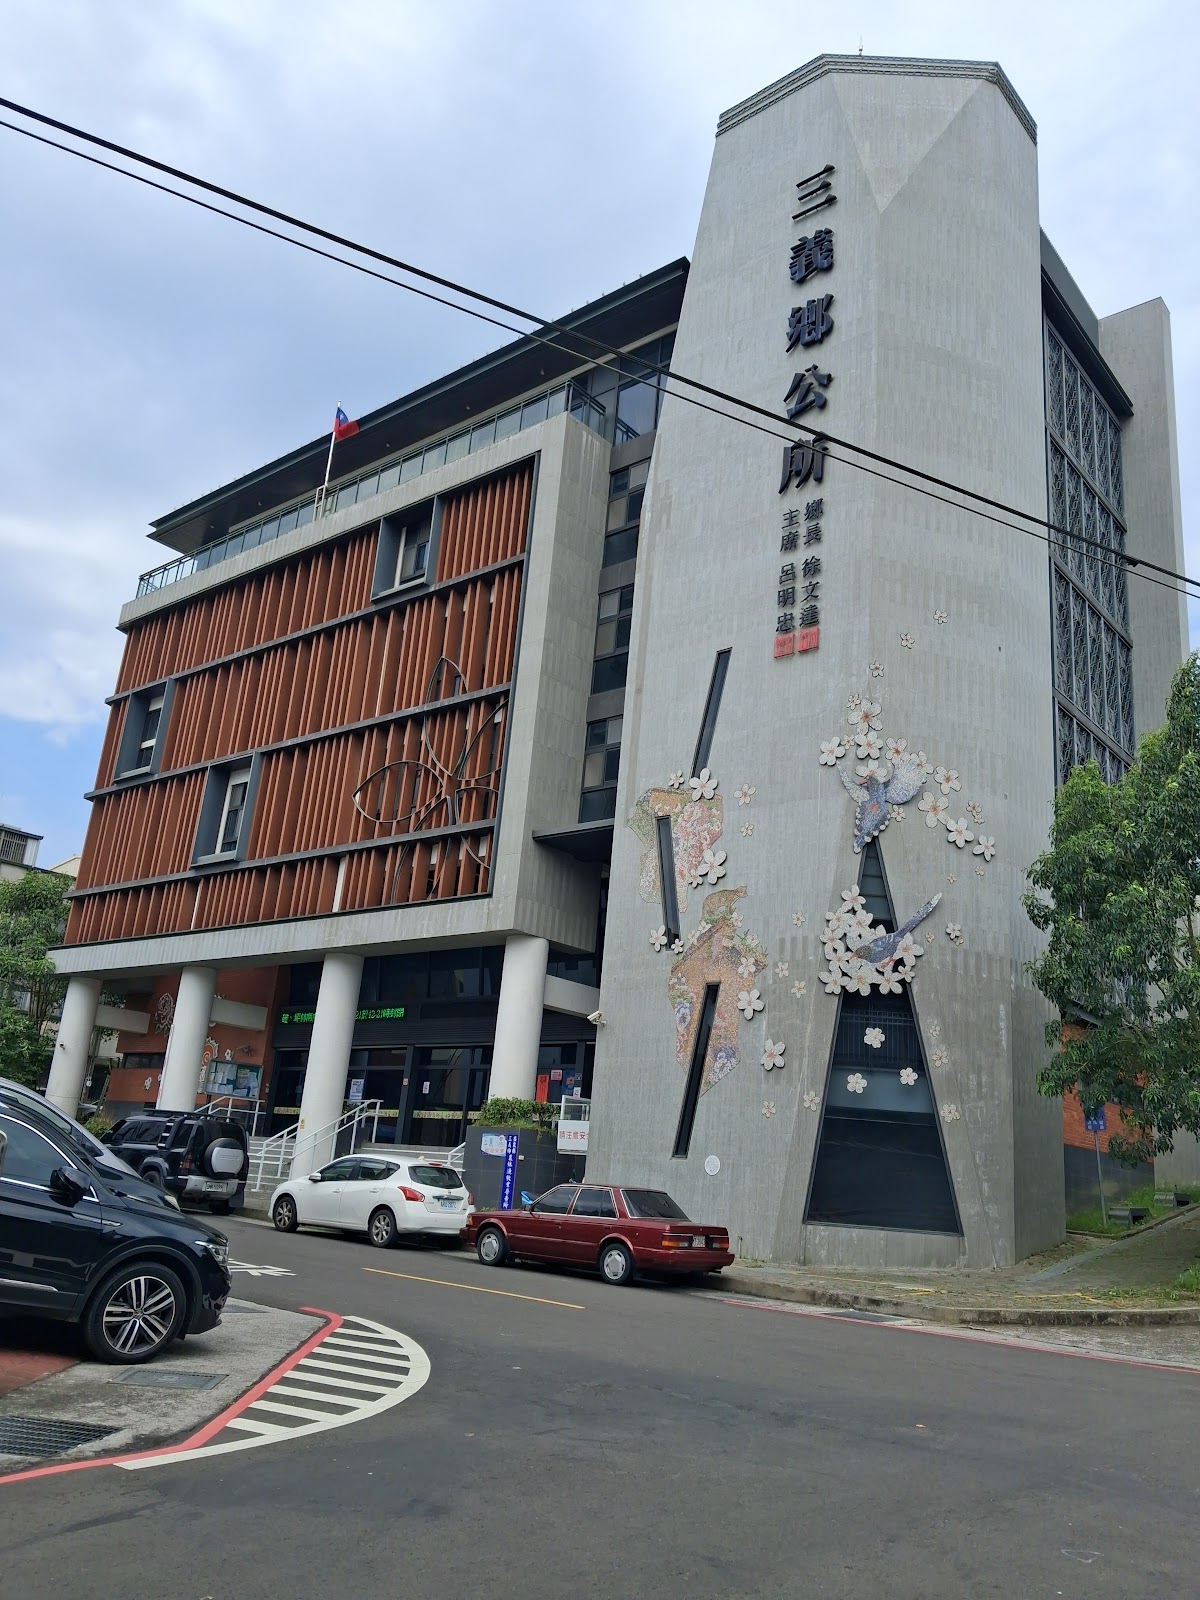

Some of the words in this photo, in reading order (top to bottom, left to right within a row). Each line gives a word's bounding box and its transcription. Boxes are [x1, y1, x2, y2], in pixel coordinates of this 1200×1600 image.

[778, 164, 838, 495] 三義鄉公所
